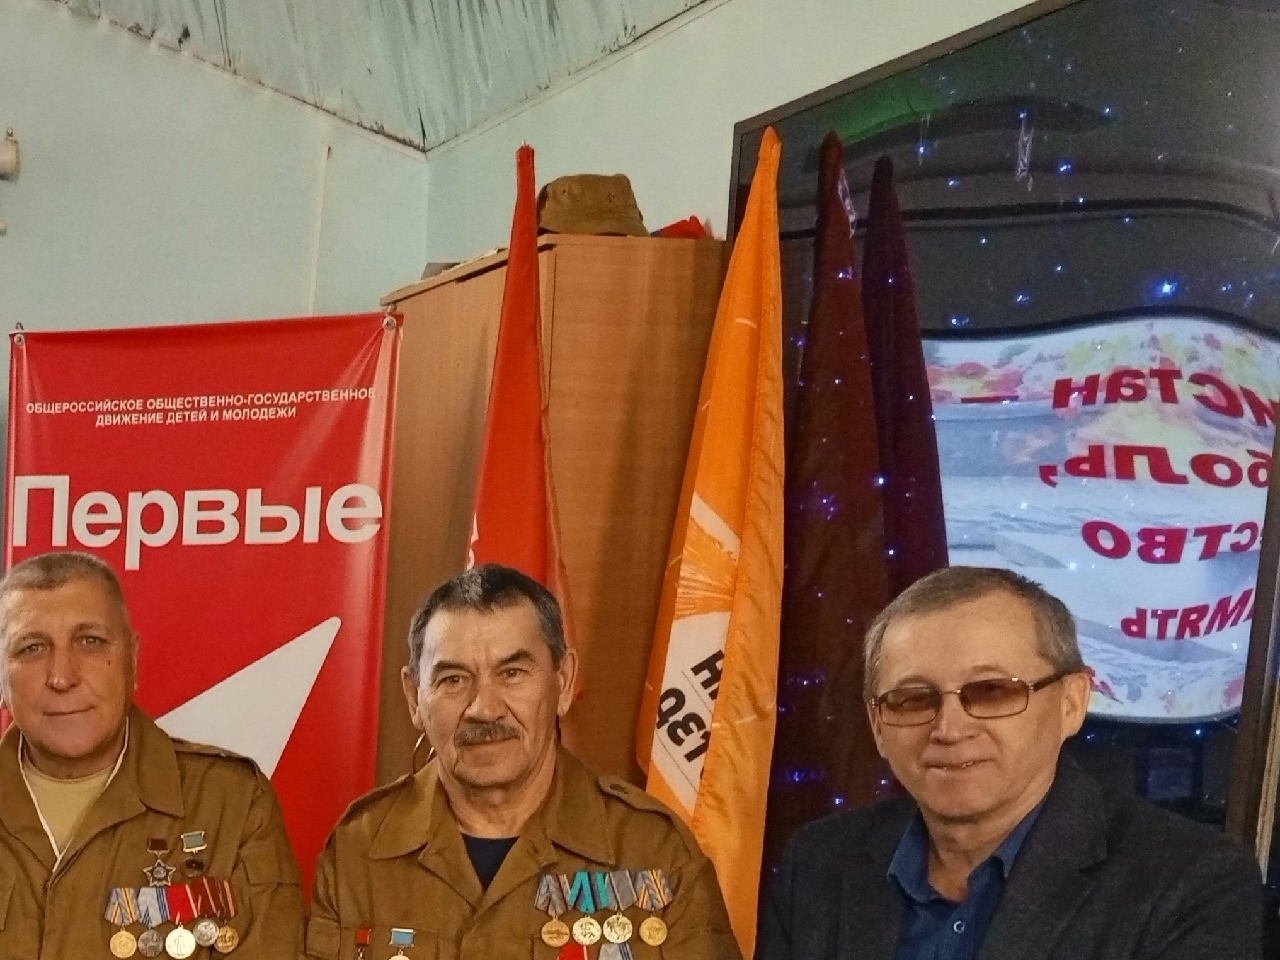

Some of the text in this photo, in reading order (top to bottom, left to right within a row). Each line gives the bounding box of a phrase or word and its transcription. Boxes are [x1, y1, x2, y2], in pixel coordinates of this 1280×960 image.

[26, 386, 376, 414] ОБЩЕРОССИЙСКОЕ ОБЩЕСТВЕННО-ГОСУДАРСТВЕННОЕ
[95, 406, 296, 427] ДВИЖЕНИЕ ДЕТЕЙ И МОЛОДЕЖИ
[13, 475, 382, 570] Первые
